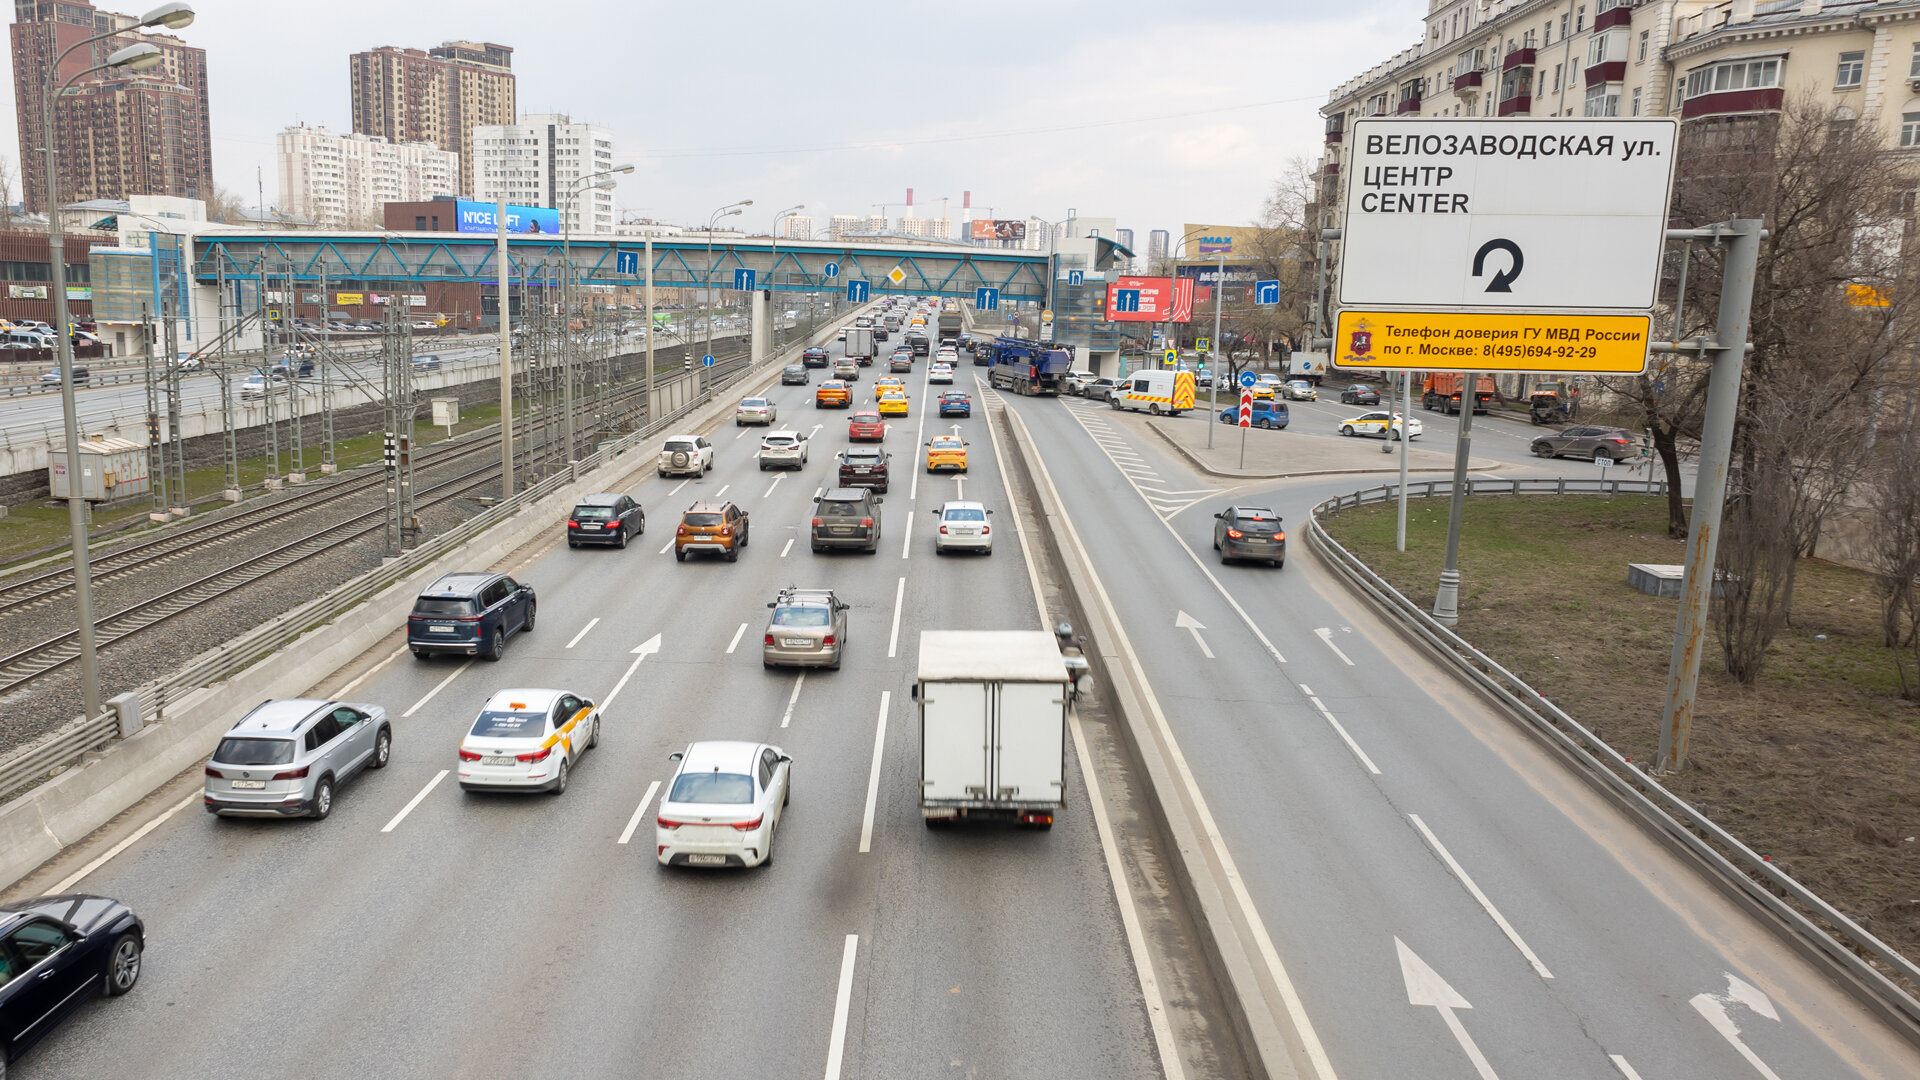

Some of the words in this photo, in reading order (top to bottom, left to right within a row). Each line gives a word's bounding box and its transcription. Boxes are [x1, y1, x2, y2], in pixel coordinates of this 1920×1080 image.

[1366, 135, 1614, 159] ВЕЛОЗАВОДСКАЯ
[1621, 140, 1661, 161] ул.
[1363, 166, 1453, 189] ЦЕНТР
[1360, 193, 1469, 213] CENTER
[493, 214, 520, 227] LFT
[1385, 325, 1451, 340] Телефон
[1454, 329, 1519, 341] доверия
[1523, 328, 1542, 340] ГУ
[1545, 328, 1580, 342] МВД
[1585, 328, 1640, 342] России
[1383, 345, 1401, 355] по
[1406, 345, 1414, 355] г.
[1419, 344, 1478, 356] Москве:
[1483, 344, 1597, 359] 8(495)694-92-29
